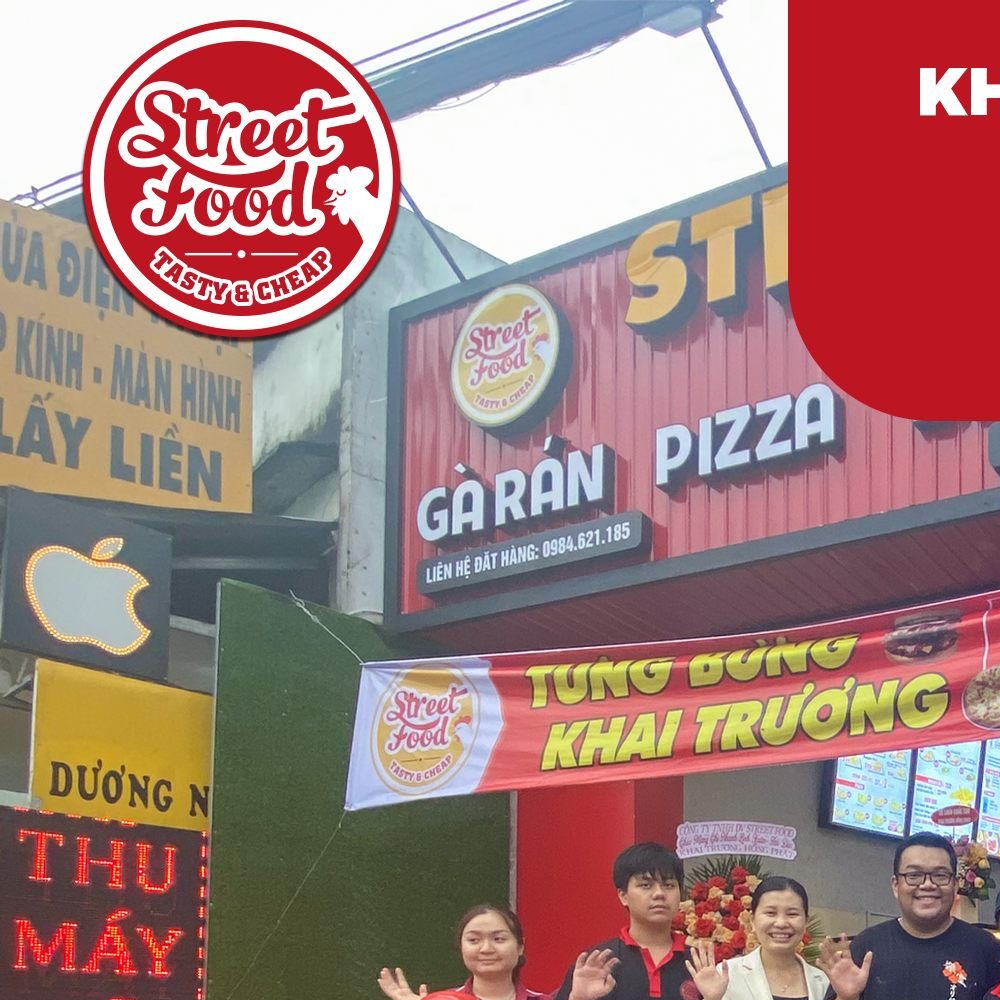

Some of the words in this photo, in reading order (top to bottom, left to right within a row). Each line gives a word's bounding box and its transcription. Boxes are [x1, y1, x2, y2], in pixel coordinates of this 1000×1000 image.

[465, 308, 541, 360] Street
[15, 312, 83, 391] KÍNH
[110, 341, 172, 415] MÀN
[180, 358, 241, 434] HÌNH
[110, 422, 222, 502] LIỀN
[655, 383, 835, 485] PIZZA
[416, 462, 486, 542] GÀ
[494, 434, 605, 526] RÁN
[426, 561, 453, 584] LIÊN
[455, 555, 471, 580] HỆ
[500, 543, 540, 568] HÀNG:
[541, 521, 632, 560] 0984.621.185
[386, 687, 468, 727] Street
[387, 716, 449, 751] Food
[540, 708, 684, 772] KHAI
[693, 674, 951, 755] TRƯƠNG
[50, 760, 173, 812] DƯƠNG
[390, 760, 415, 781] TASTY
[424, 755, 452, 780] CHEAP
[18, 829, 177, 893] THU
[13, 908, 185, 978] MÁY
